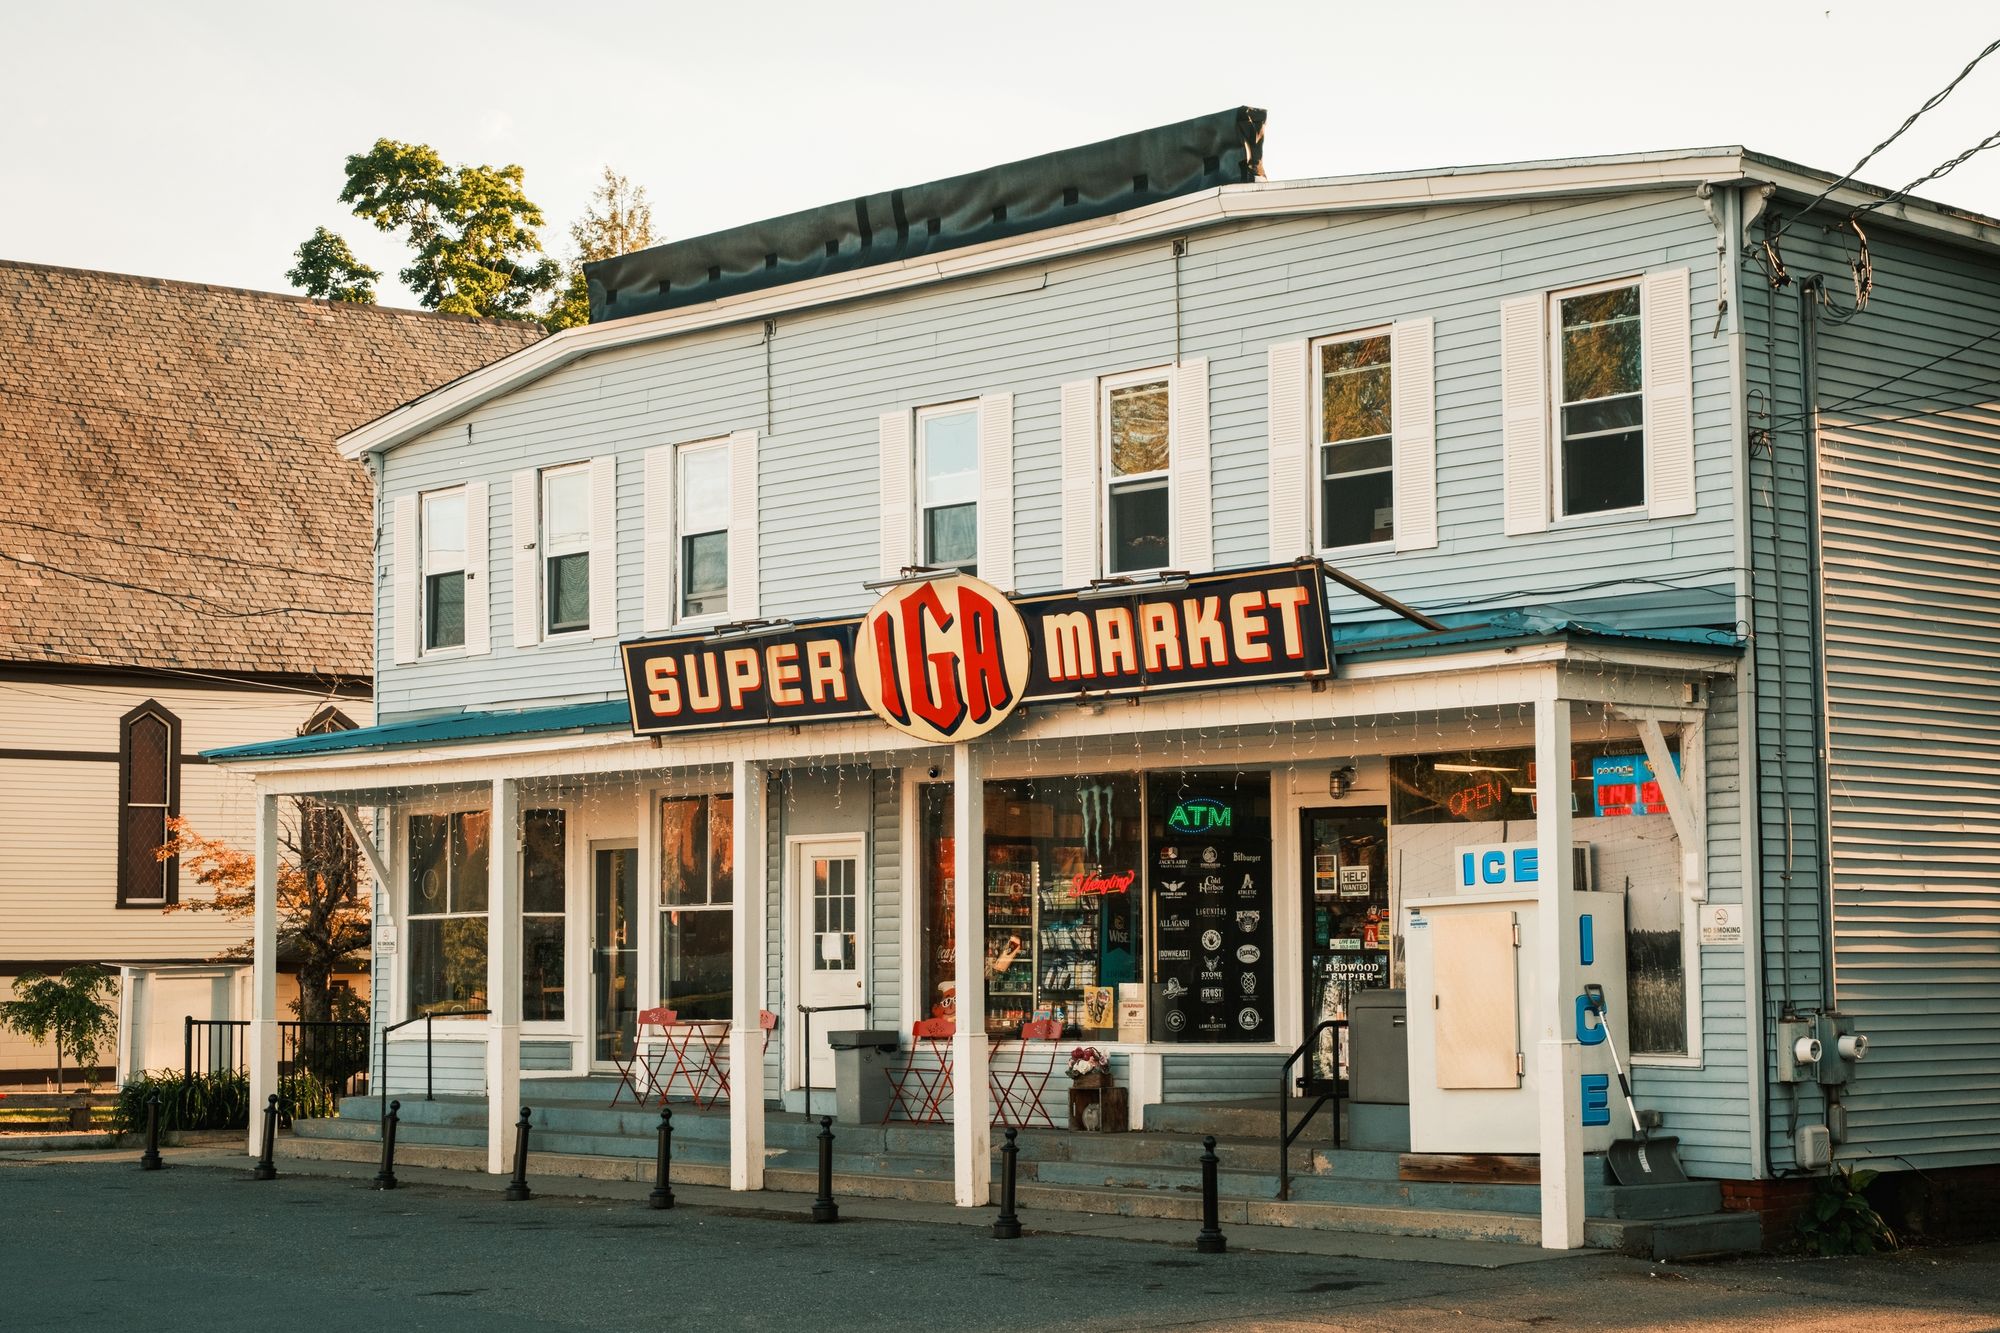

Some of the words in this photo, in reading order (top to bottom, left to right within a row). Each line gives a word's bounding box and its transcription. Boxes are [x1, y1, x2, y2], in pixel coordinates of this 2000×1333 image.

[644, 638, 847, 717] SUPER
[873, 581, 1013, 737] IGA
[1044, 586, 1310, 683] MARKET
[1449, 781, 1501, 816] OPEN
[1169, 806, 1231, 827] ATM
[1463, 848, 1539, 886] ICE
[1205, 875, 1221, 885] Cold
[1343, 872, 1367, 882] HELP
[1069, 869, 1135, 897] Yuengling
[1199, 882, 1224, 894] Harbor
[1342, 883, 1368, 891] WANTED
[1195, 907, 1227, 916] LAGUNITAS
[1160, 919, 1190, 927] ALLAGASH
[1713, 926, 1741, 934] SMOKING
[1109, 929, 1129, 943] WISE
[1325, 963, 1379, 972] REDWOOD
[1331, 972, 1374, 981] EMPIRE
